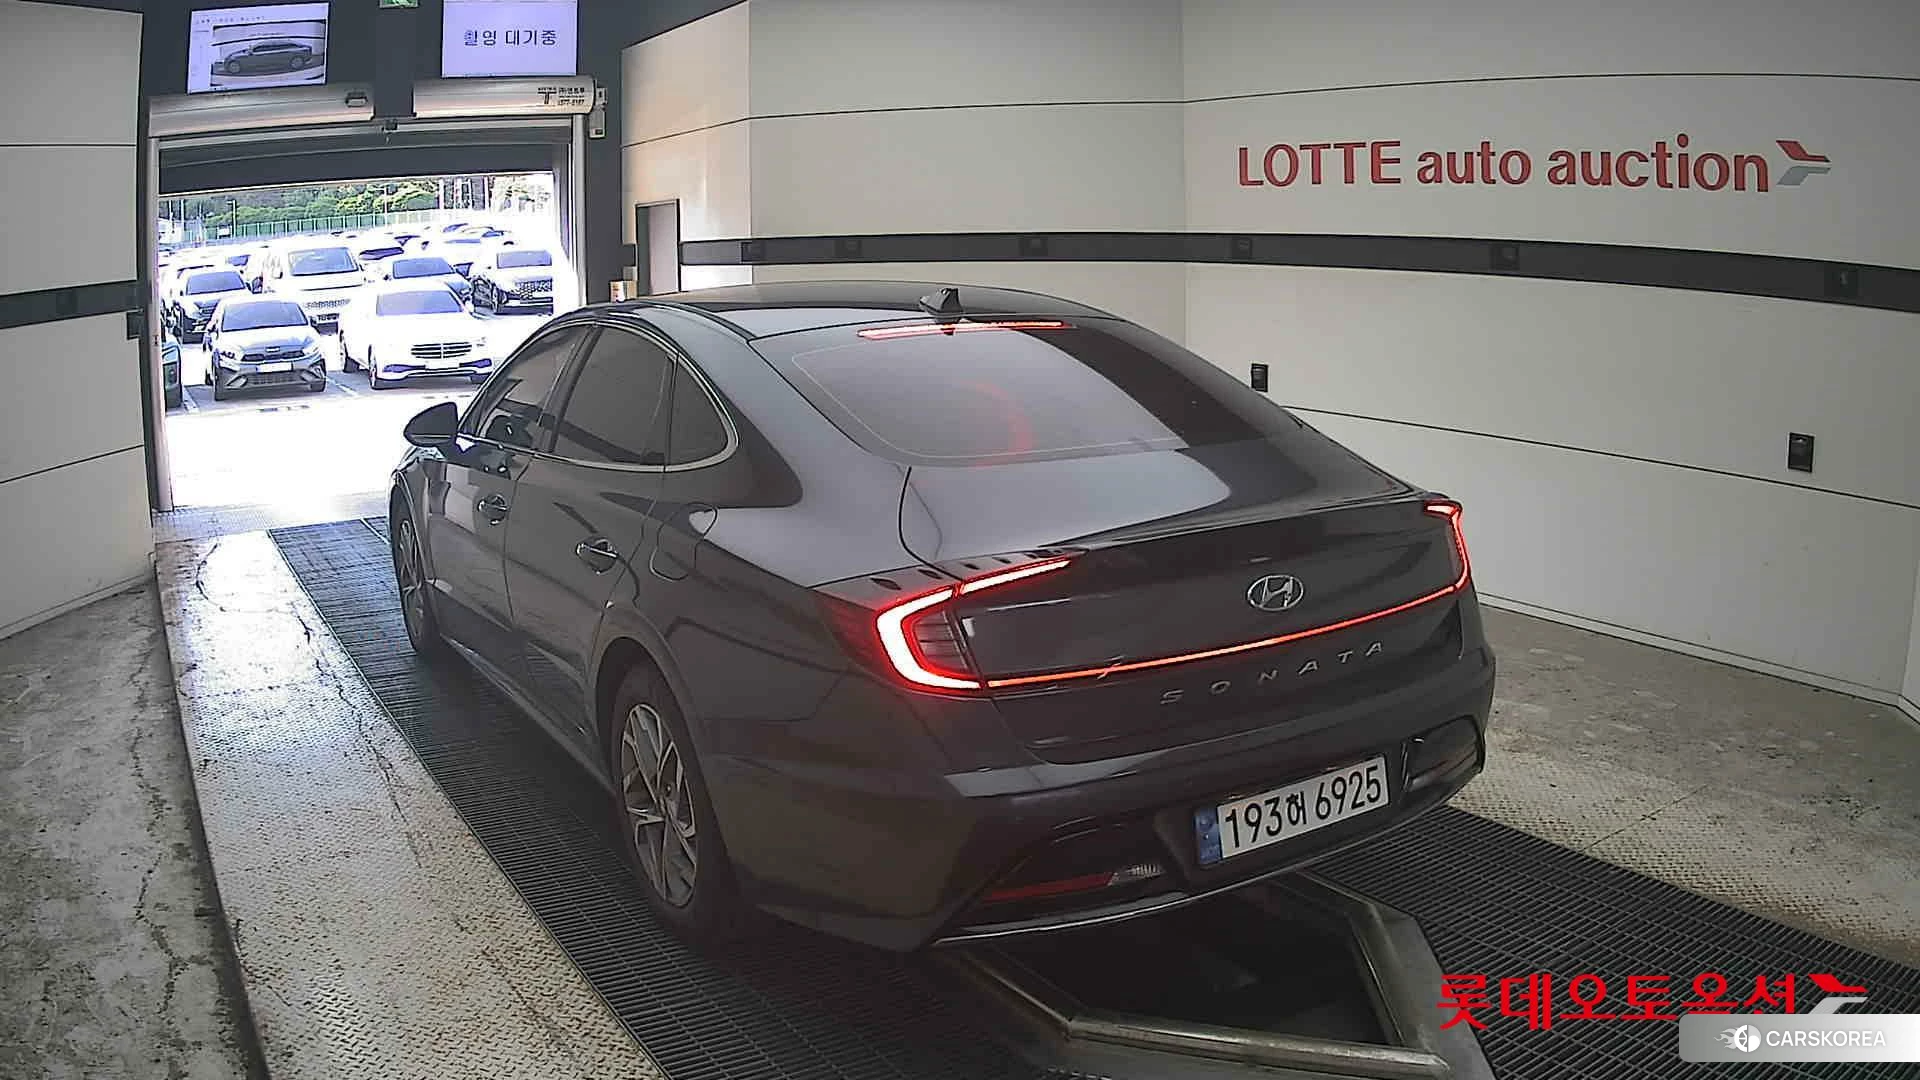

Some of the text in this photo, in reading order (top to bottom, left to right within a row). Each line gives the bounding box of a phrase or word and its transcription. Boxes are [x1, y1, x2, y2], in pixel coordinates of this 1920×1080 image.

[505, 30, 557, 46] 대기중
[1239, 133, 1768, 192] LOTTE auto auction
[1160, 642, 1384, 704] SONATA
[1315, 765, 1381, 820] 6925
